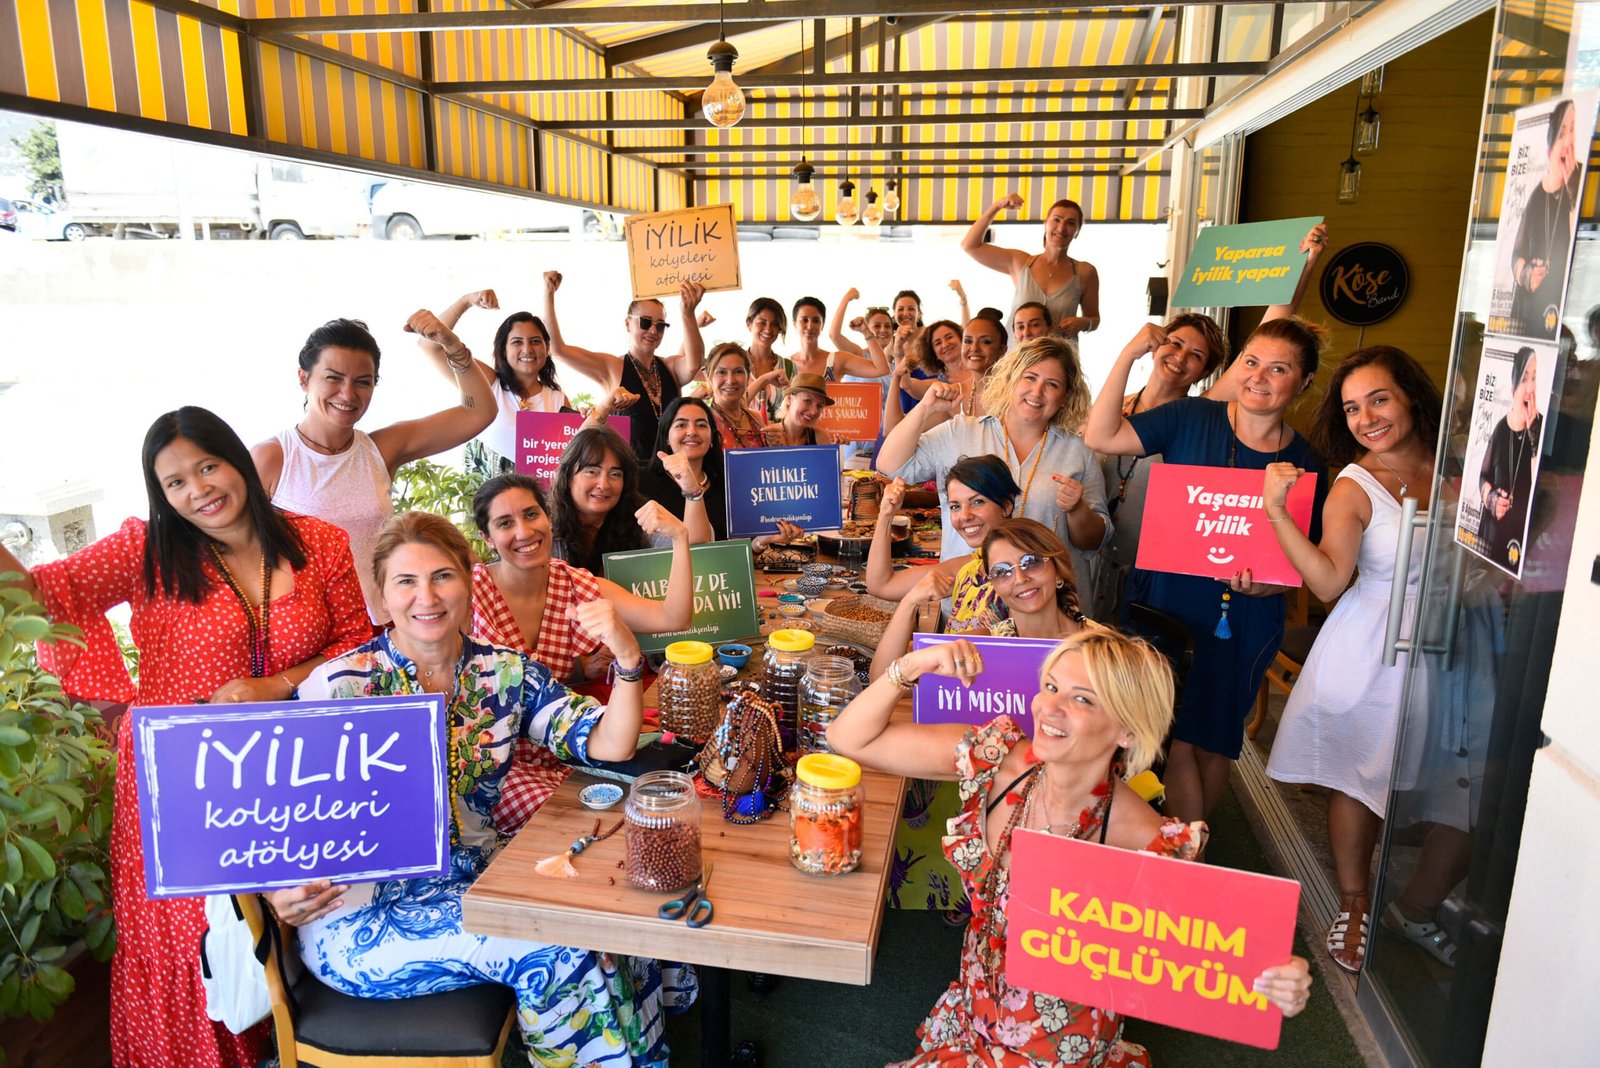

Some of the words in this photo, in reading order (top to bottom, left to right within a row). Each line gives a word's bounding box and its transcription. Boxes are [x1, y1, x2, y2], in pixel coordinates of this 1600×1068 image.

[646, 217, 722, 250] İYİLİK
[650, 248, 717, 269] kolyeleri
[1215, 245, 1286, 264] Yaparsa
[1192, 265, 1235, 286] iyilik
[1235, 265, 1291, 284] yapar
[1331, 263, 1391, 305] Köşe
[1367, 287, 1400, 309] Band
[832, 396, 862, 407] HUMUZ
[523, 438, 538, 449] bir
[761, 466, 807, 484] İYİLİKLE
[750, 483, 819, 506] ŞENLENDİK!
[1195, 512, 1254, 537] iyilik
[632, 575, 704, 598] KALBZ
[708, 572, 730, 592] DE
[717, 589, 742, 612] İYİ!
[938, 685, 961, 711] İYİ
[968, 688, 1026, 715] MİSİN
[195, 722, 407, 790] İYİLİK
[204, 790, 391, 832] kolyeleri
[219, 831, 379, 870] atölyesi
[1050, 887, 1247, 958] KADINIM
[1020, 926, 1268, 1011] GÜÇLÜYÜM
